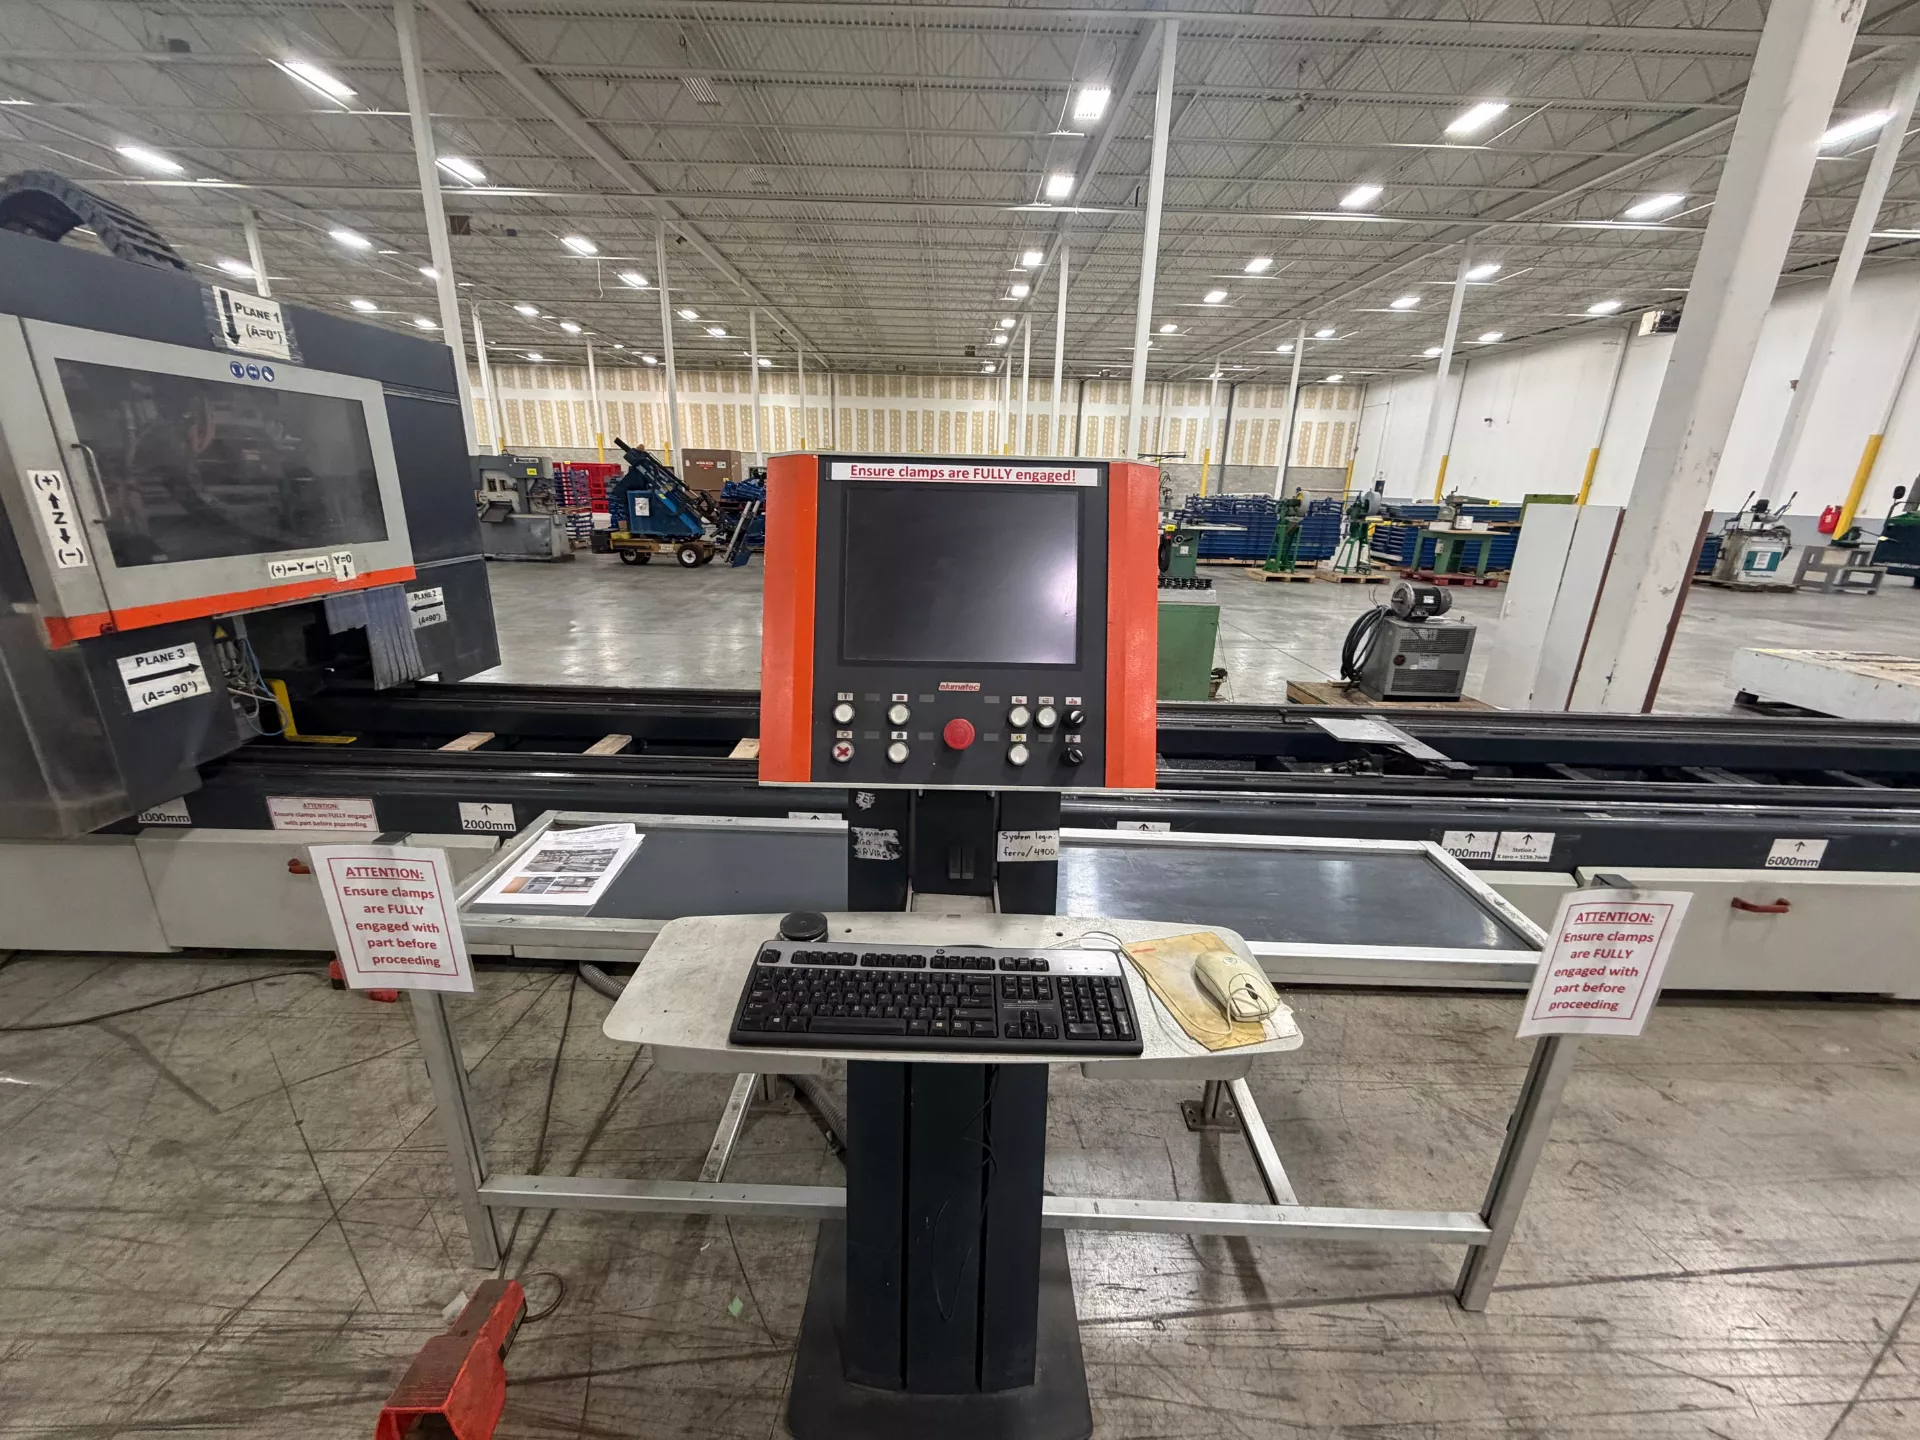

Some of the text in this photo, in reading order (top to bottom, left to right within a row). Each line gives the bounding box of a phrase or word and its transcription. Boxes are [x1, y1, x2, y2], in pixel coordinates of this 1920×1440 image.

[234, 302, 280, 323] PLANE 1
[850, 464, 1077, 483] Ensure clamps are FULLY engaged!
[35, 474, 60, 491] (+)
[52, 512, 68, 525] Z
[333, 554, 352, 565] Y=0
[413, 591, 432, 600] PLANE
[135, 648, 186, 667] PLANE 3
[940, 682, 979, 690] elumatec
[139, 812, 191, 822] 1000mm
[463, 819, 515, 831] 2000mm
[1001, 831, 1031, 843] System
[1767, 856, 1819, 867] 6000mm
[346, 866, 425, 881] ATTENTION:
[343, 886, 435, 901] Ensure clamps
[363, 904, 424, 915] are FULLY
[1574, 911, 1655, 925] ATTENTION:
[355, 921, 440, 934] engaged with
[367, 937, 437, 950] part before
[1563, 931, 1655, 944] Ensure clamps
[1570, 948, 1634, 959] are FULLY
[372, 955, 441, 968] proceeding
[1554, 966, 1639, 978] engaged with
[1554, 982, 1626, 996] part before
[1549, 1000, 1620, 1013] proceeding
